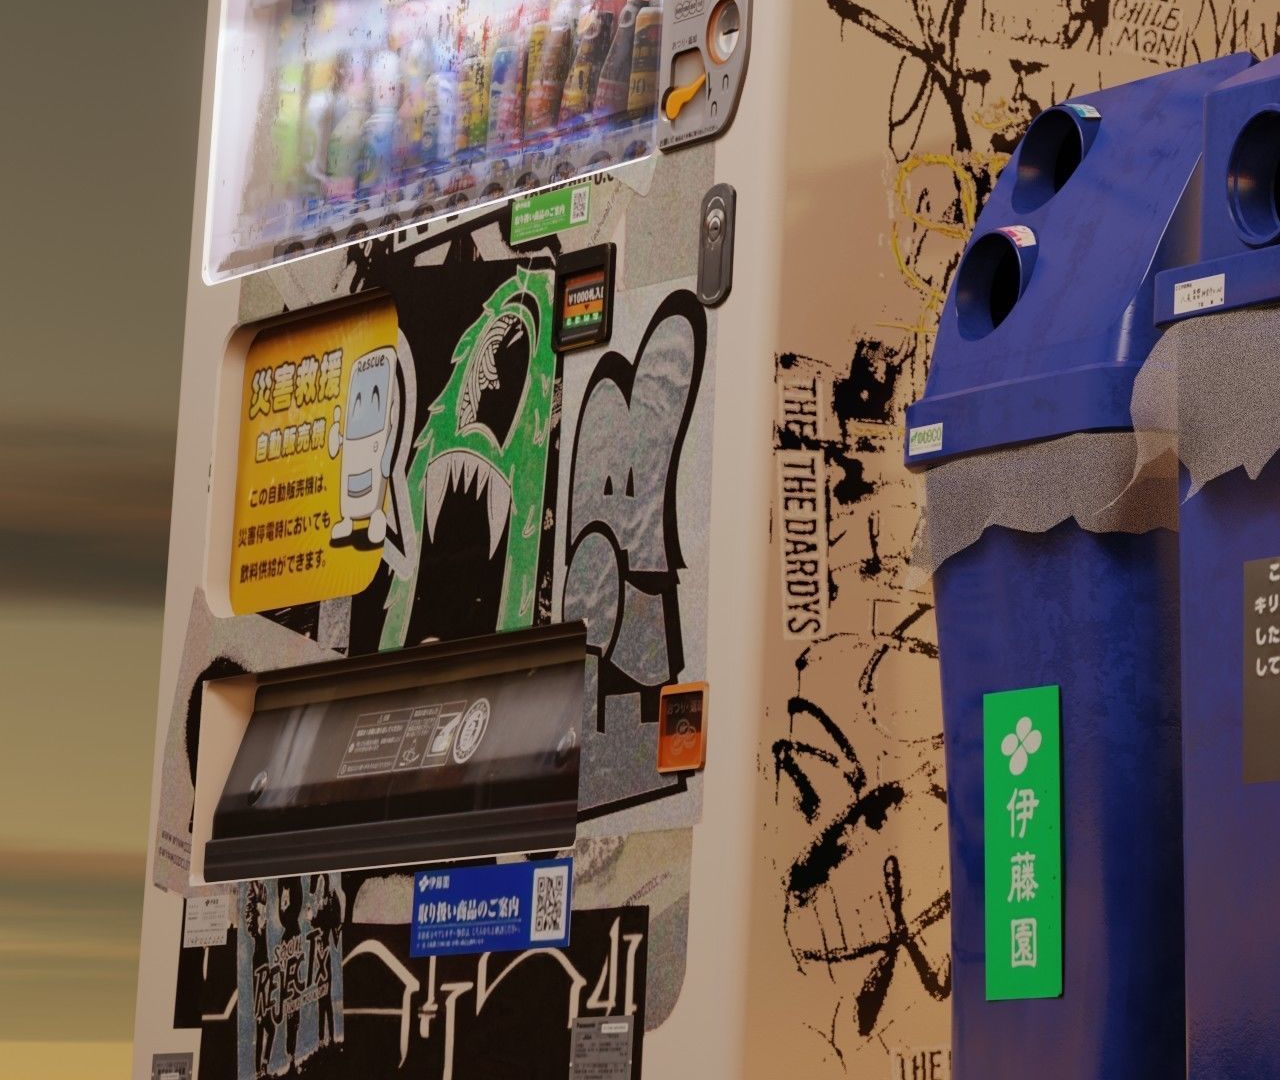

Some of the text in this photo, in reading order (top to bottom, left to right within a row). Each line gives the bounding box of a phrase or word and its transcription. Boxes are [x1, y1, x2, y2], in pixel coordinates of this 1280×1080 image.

[357, 352, 386, 374] Rescue
[249, 347, 343, 420] 災害救援
[254, 417, 327, 464] 自動販売機
[249, 476, 328, 508] この自動販売機は、
[783, 457, 817, 511] THE
[237, 511, 331, 549] 災害停電時においても
[239, 548, 326, 585] 飲料供給ができます。
[1006, 787, 1040, 969] 伊藤園
[418, 896, 520, 925] 取り扱い商品のご案内
